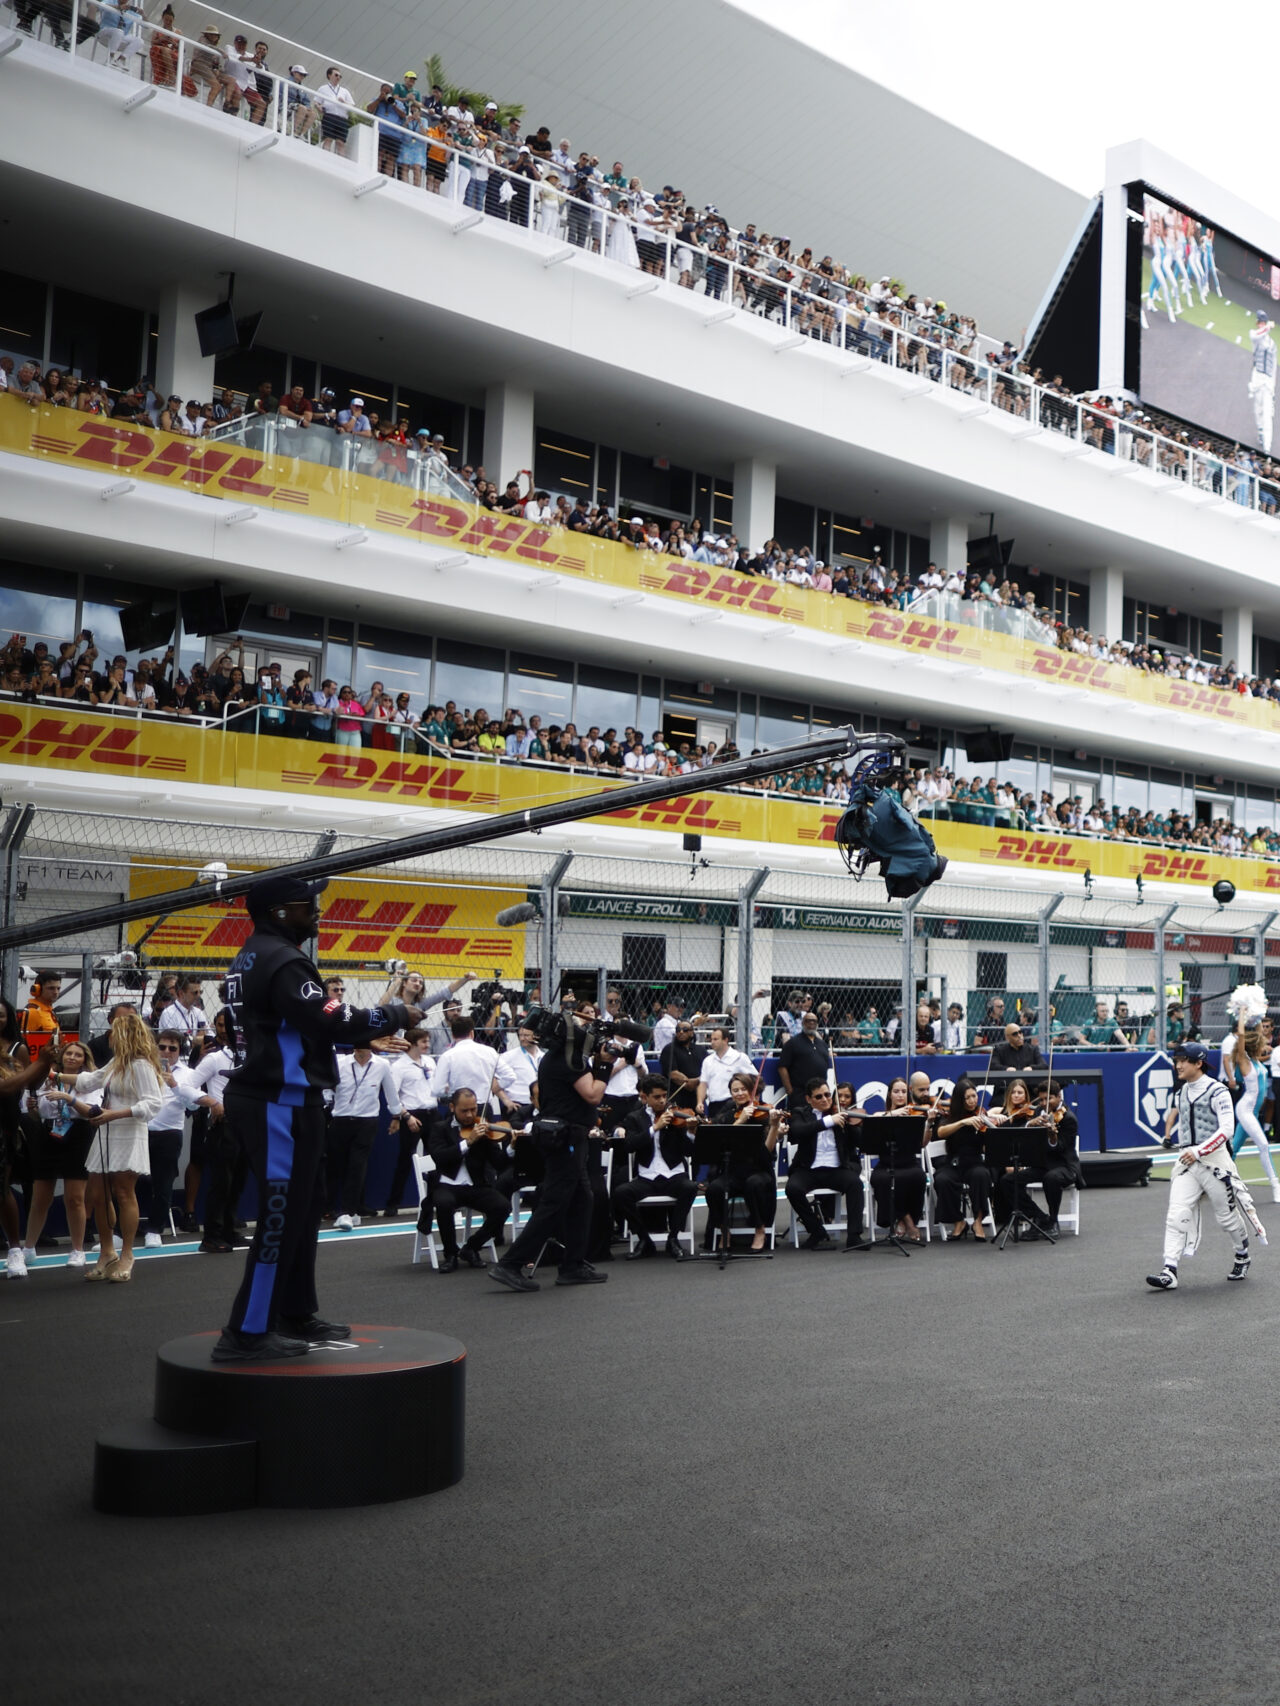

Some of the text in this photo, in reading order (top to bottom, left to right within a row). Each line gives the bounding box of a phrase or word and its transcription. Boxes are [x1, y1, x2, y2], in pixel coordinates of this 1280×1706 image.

[72, 421, 275, 497] DHL
[406, 499, 561, 563] DHL
[664, 563, 787, 614] DHL
[866, 611, 965, 655] DHL
[1033, 649, 1111, 689] DHL
[1168, 683, 1236, 718] DHL
[0, 713, 152, 768] HL
[314, 753, 473, 802] DHL
[995, 835, 1076, 867] DHL
[1141, 853, 1209, 881] DHL
[27, 865, 47, 878] F1
[54, 867, 113, 882] TEAM
[587, 899, 684, 916] LANCE STROLL
[781, 908, 903, 929] 14 FERNANDO ALONS
[259, 1181, 289, 1263] FOCUS
